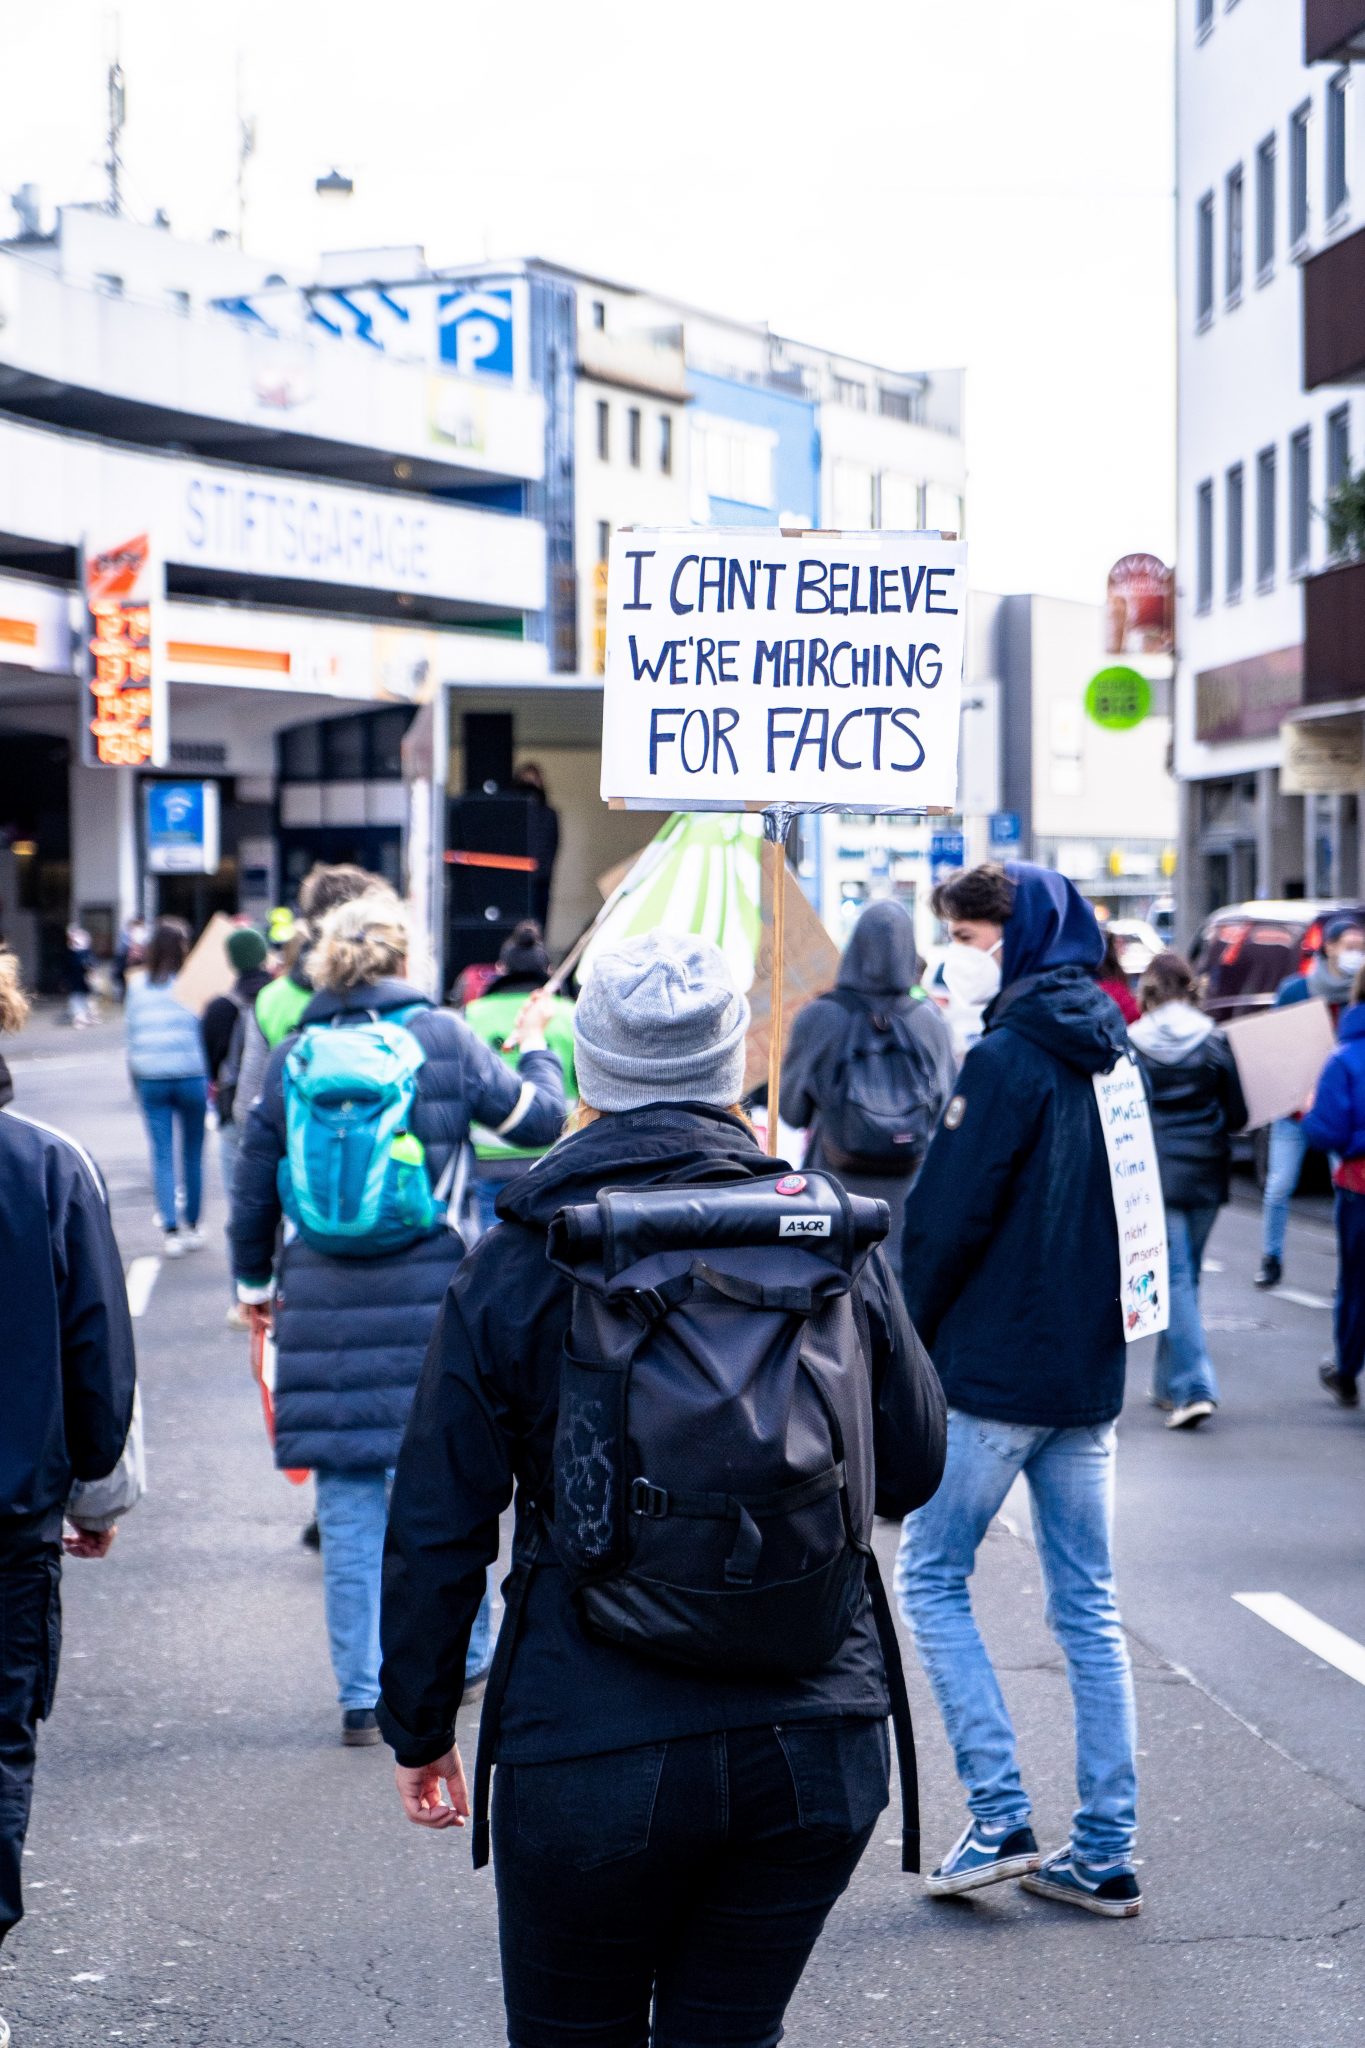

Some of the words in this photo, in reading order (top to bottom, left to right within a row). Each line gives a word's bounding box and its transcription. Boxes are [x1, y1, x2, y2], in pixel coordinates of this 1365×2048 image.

[622, 550, 657, 611] I
[669, 554, 787, 616] CAN'T
[795, 559, 959, 616] BELIEVE
[628, 634, 741, 686] WE'RE
[752, 637, 943, 689] MARCHING
[648, 707, 740, 776] FOR
[766, 706, 926, 773] FACTS
[1114, 1159, 1146, 1179] Klima
[1124, 1222, 1148, 1242] nicht
